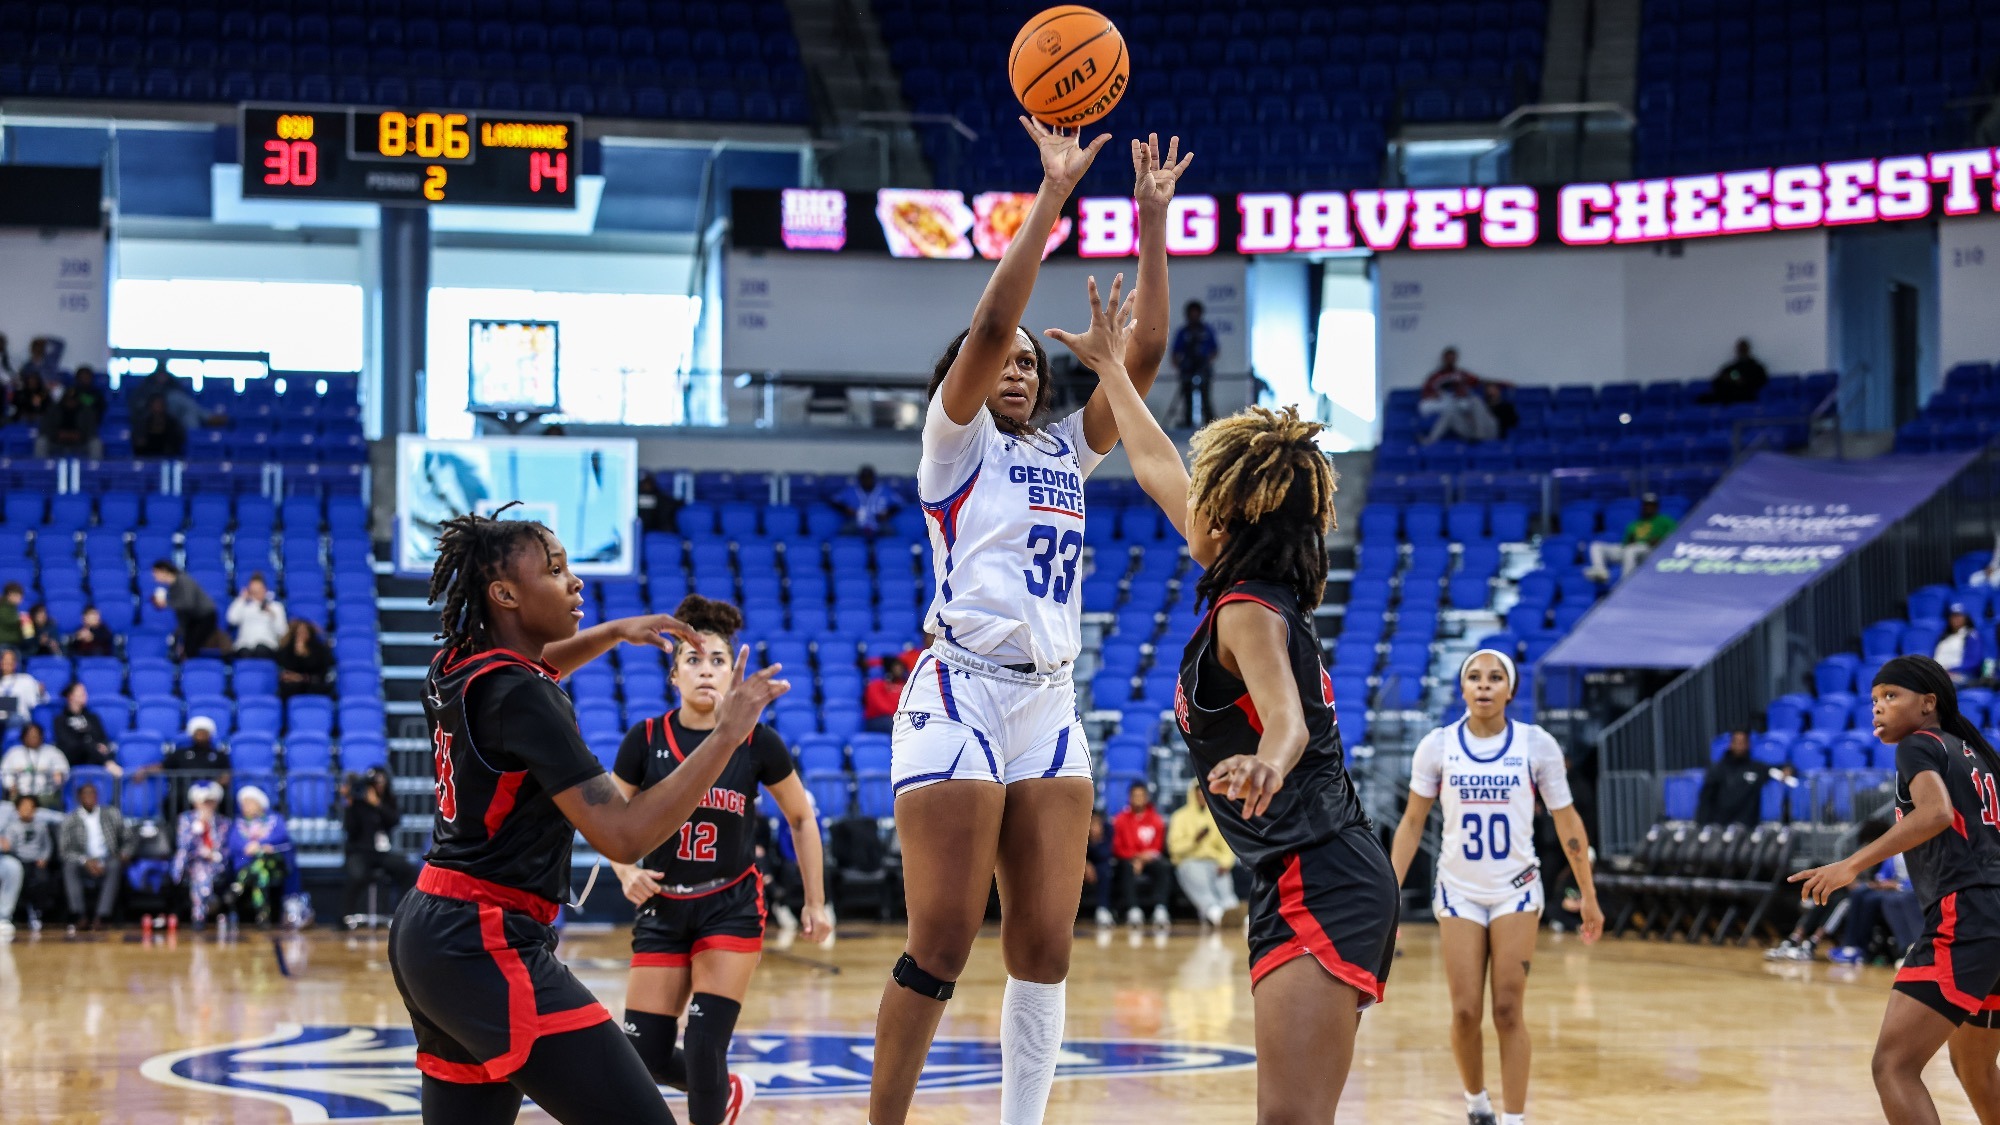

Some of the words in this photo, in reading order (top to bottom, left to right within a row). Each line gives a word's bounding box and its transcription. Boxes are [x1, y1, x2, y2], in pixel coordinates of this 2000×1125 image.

[1056, 72, 1128, 125] Wilson
[378, 111, 470, 159] 8:06
[264, 140, 317, 186] 30
[423, 165, 447, 200] 2
[529, 151, 568, 193] 14
[1078, 194, 1219, 258] BG
[1237, 186, 1538, 253] DAVE'S
[1557, 147, 2000, 247] CHEESEST
[1009, 465, 1082, 496] GEORG
[1029, 486, 1083, 513] STATE
[1023, 524, 1083, 605] 33
[1449, 775, 1520, 787] GEORGIA
[1460, 788, 1510, 800] STATE
[699, 787, 747, 817] ANGE
[677, 821, 718, 861] 12
[1462, 813, 1510, 861] 30
